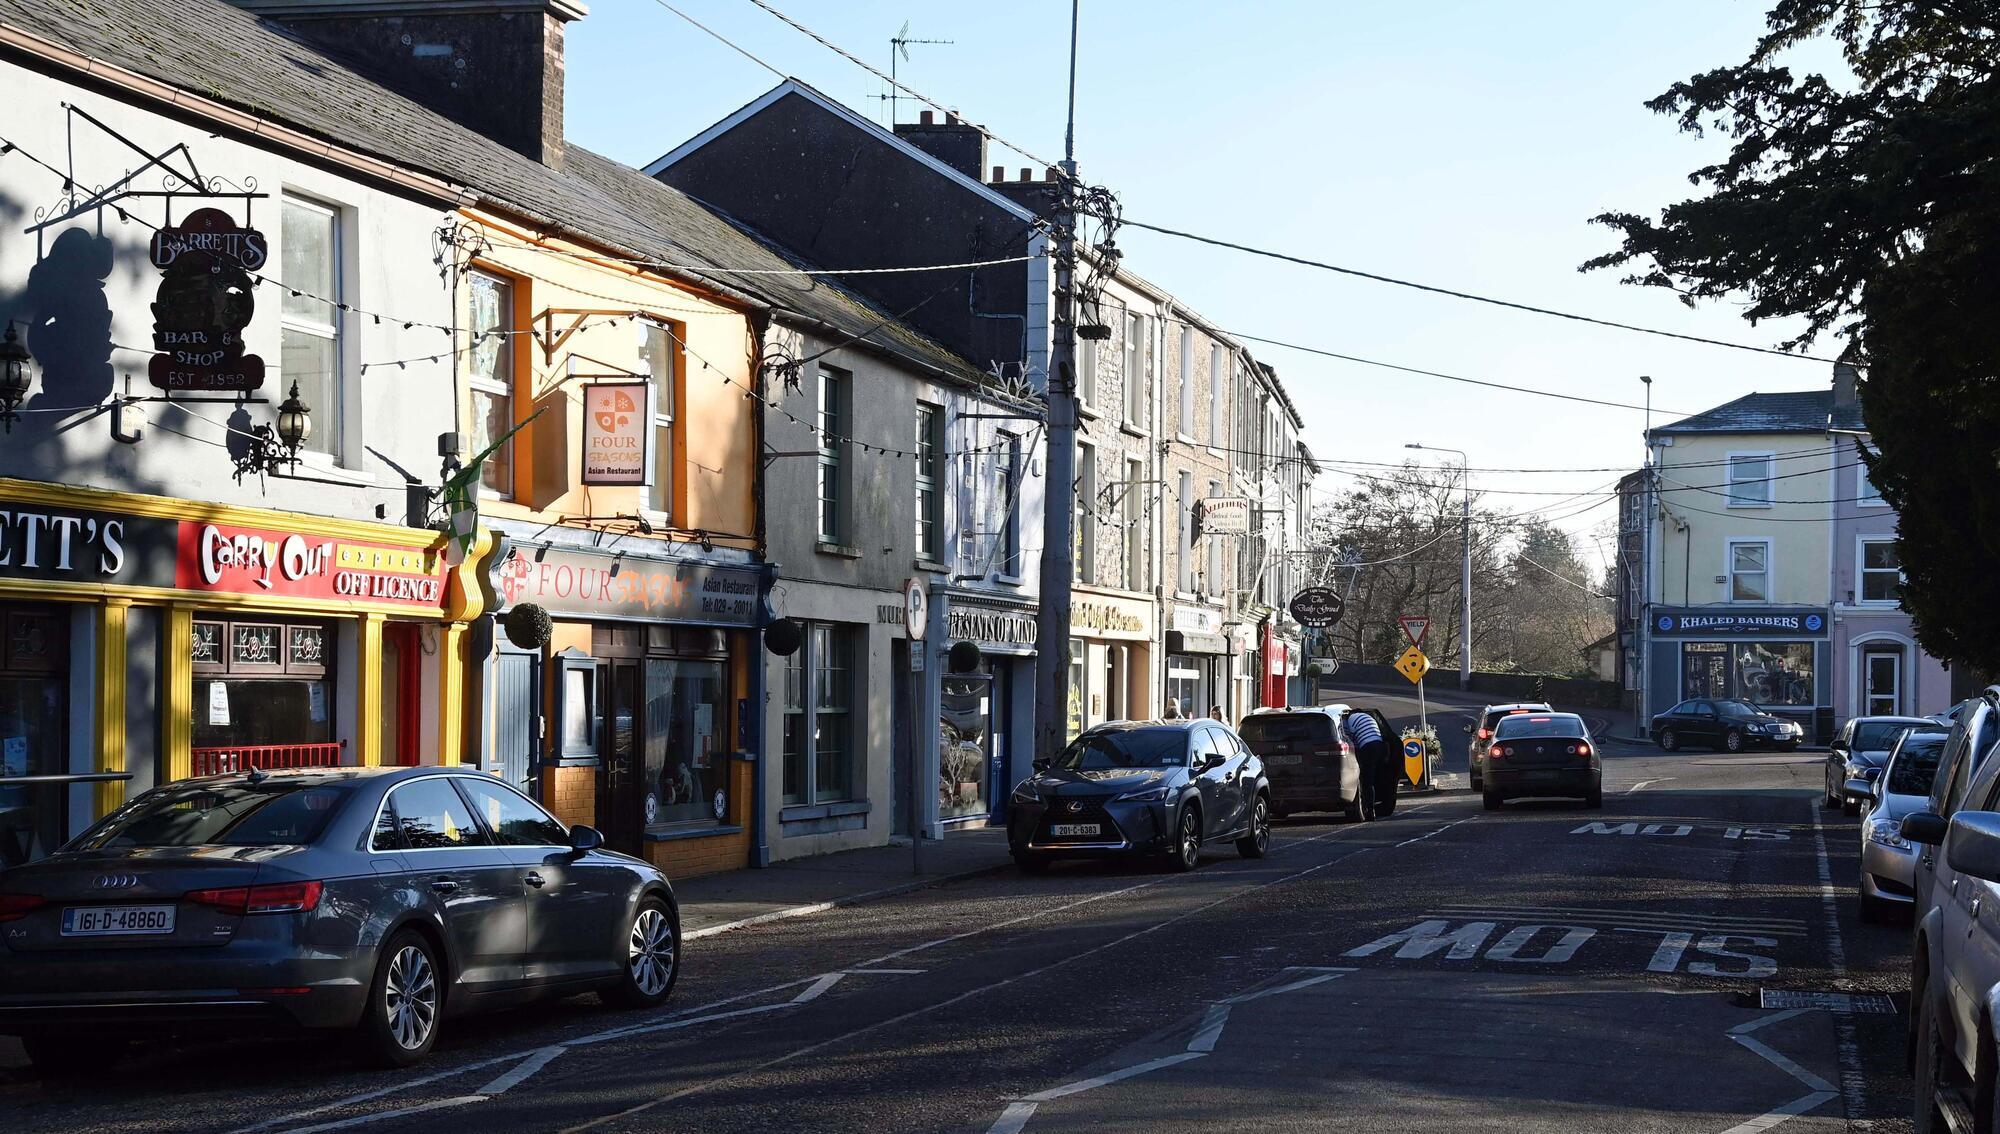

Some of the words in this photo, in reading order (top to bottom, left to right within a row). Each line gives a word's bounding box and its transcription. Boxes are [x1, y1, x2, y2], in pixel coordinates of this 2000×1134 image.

[156, 232, 266, 269] BARRETT'S
[164, 331, 208, 344] BAR
[222, 332, 232, 345] &
[176, 350, 225, 366] SHOP
[169, 371, 195, 386] EST
[592, 436, 637, 448] FOUR
[588, 452, 641, 463] SEASONS
[588, 467, 605, 475] Asian
[607, 466, 641, 475] Restaurant
[337, 571, 369, 596] OFF
[372, 573, 440, 602] LICENCE
[536, 562, 612, 602] FOUR
[702, 576, 721, 593] Asian
[722, 578, 756, 596] Restaurant
[713, 598, 727, 613] 029
[1310, 595, 1325, 603] The
[912, 588, 922, 627] P
[1295, 603, 1316, 614] Daily
[1316, 604, 1341, 615] Grind
[948, 611, 995, 641] RESENTS
[1012, 617, 1038, 644] MIND
[1680, 617, 1734, 629] KHALED
[1737, 616, 1799, 629] BARBERS
[79, 911, 166, 930] 161-D-48860
[9, 928, 27, 938] A4
